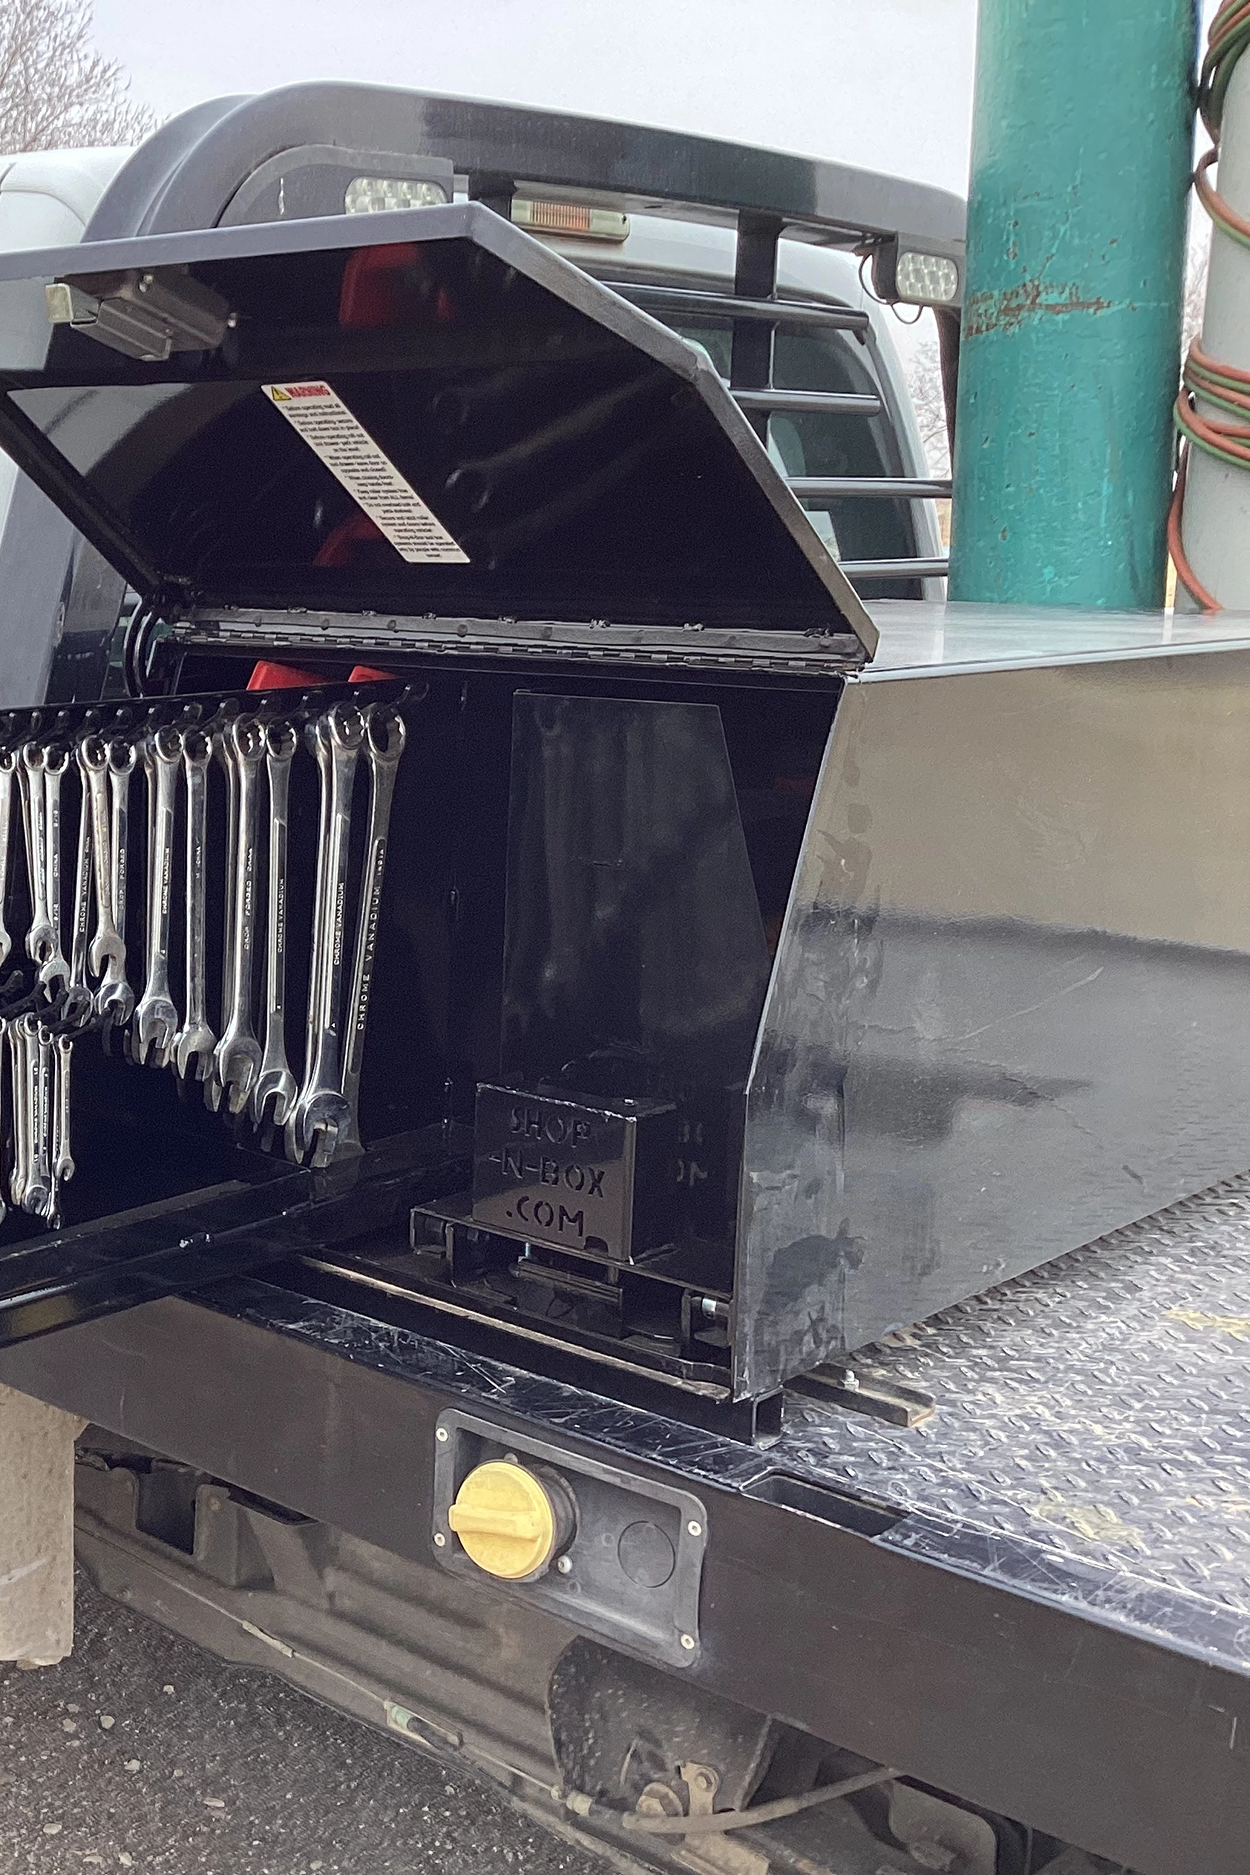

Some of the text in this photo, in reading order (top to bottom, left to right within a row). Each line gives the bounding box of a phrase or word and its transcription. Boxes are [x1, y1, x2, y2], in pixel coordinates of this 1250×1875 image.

[82, 858, 90, 896] VANADIUM
[334, 882, 345, 966] CHROME VANADIUM
[357, 973, 370, 1031] CHROME
[365, 885, 382, 962] VANADIUM
[510, 1106, 590, 1148] SHOP
[488, 1147, 605, 1198] -N-BOX
[505, 1195, 585, 1237] .COM
